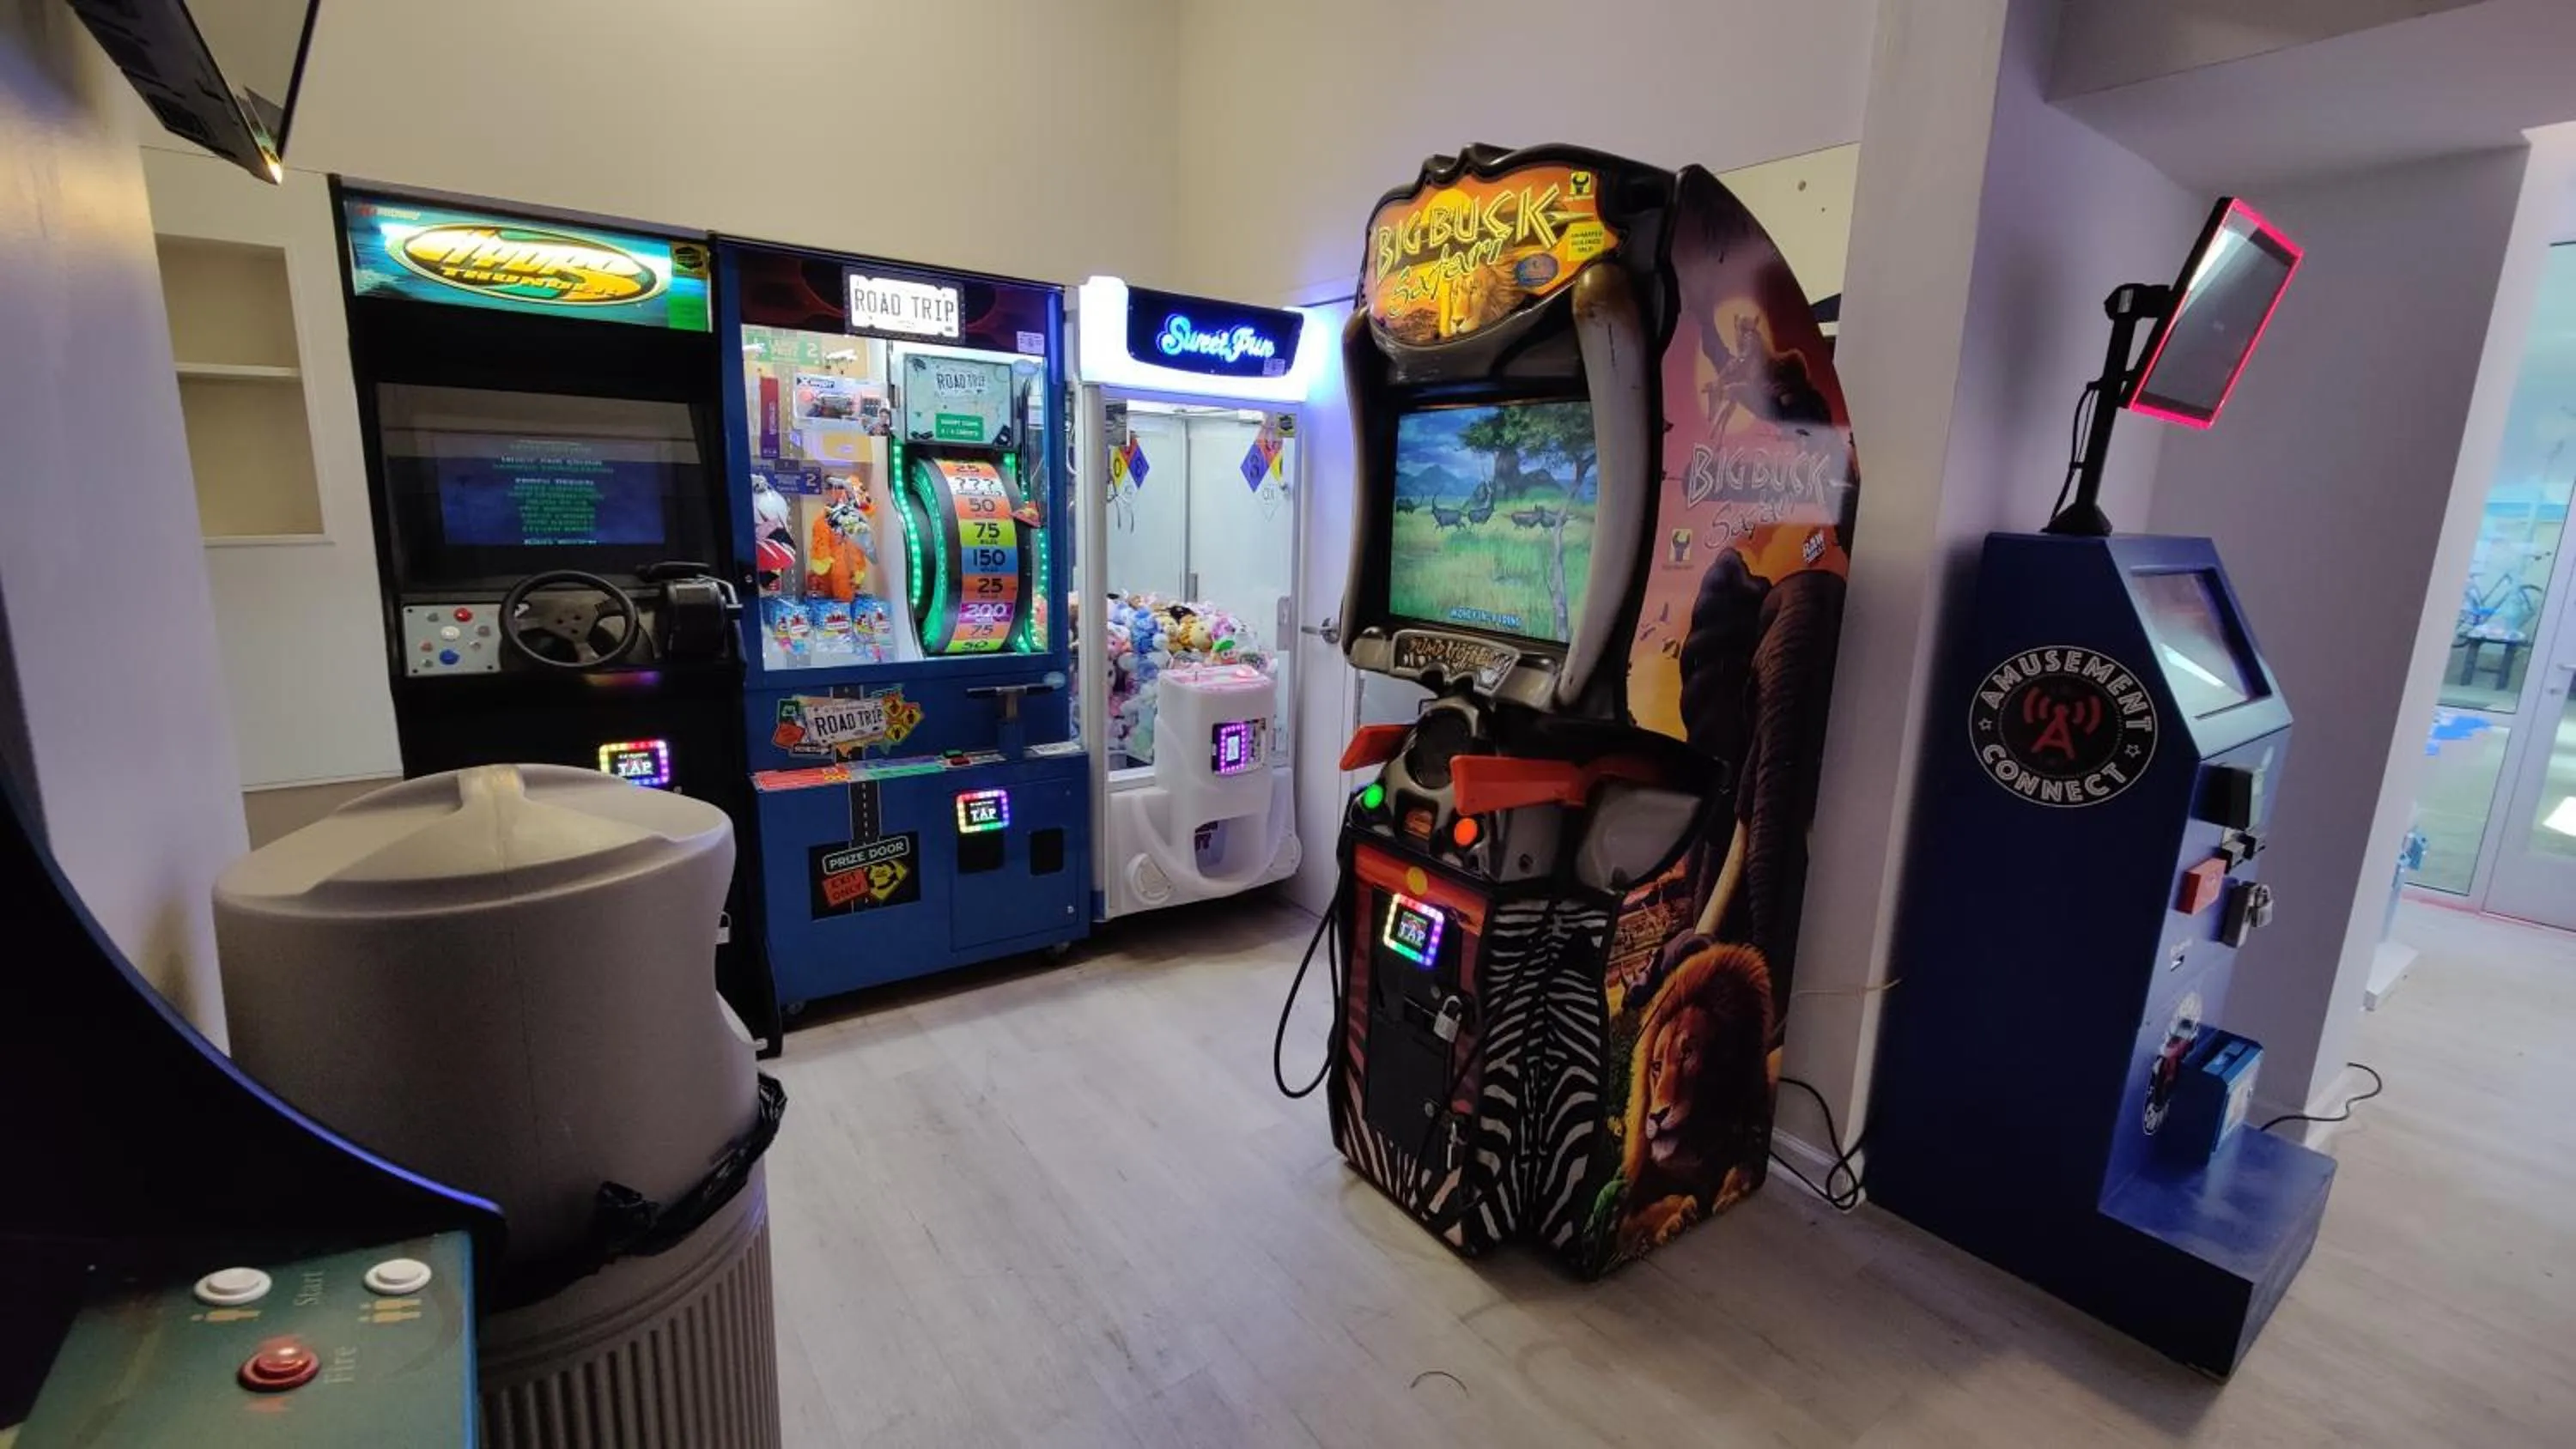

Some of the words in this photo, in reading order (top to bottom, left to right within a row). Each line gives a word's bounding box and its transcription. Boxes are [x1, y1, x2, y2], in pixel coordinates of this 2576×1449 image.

[1377, 211, 1420, 283] BIG
[1429, 183, 1560, 250] BUCK
[854, 288, 902, 316] ROAD
[911, 295, 954, 323] TRIP
[1157, 314, 1231, 356] Sweet
[1223, 326, 1275, 362] Fun
[936, 373, 966, 391] ROAD
[1687, 443, 1745, 509] BIG
[1752, 447, 1830, 504] BUCK
[969, 498, 995, 512] 50
[974, 522, 1001, 538] 75
[973, 549, 1006, 567] 150
[977, 578, 1004, 593] 25
[968, 603, 1007, 617] 200
[971, 624, 993, 637] 75
[1980, 650, 2153, 732] AMUSEMENT
[815, 712, 857, 737] ROAD
[858, 709, 883, 728] TRIP
[618, 761, 653, 775] TAP
[1983, 744, 2127, 802] CONNECT
[970, 807, 997, 822] TAP
[829, 851, 866, 869] PRIZE
[869, 841, 904, 858] DOOR
[830, 872, 857, 888] EXIT
[831, 883, 862, 900] ONLY
[1398, 921, 1426, 949] TAP
[293, 1270, 325, 1307] Start
[324, 1345, 358, 1385] Fire
